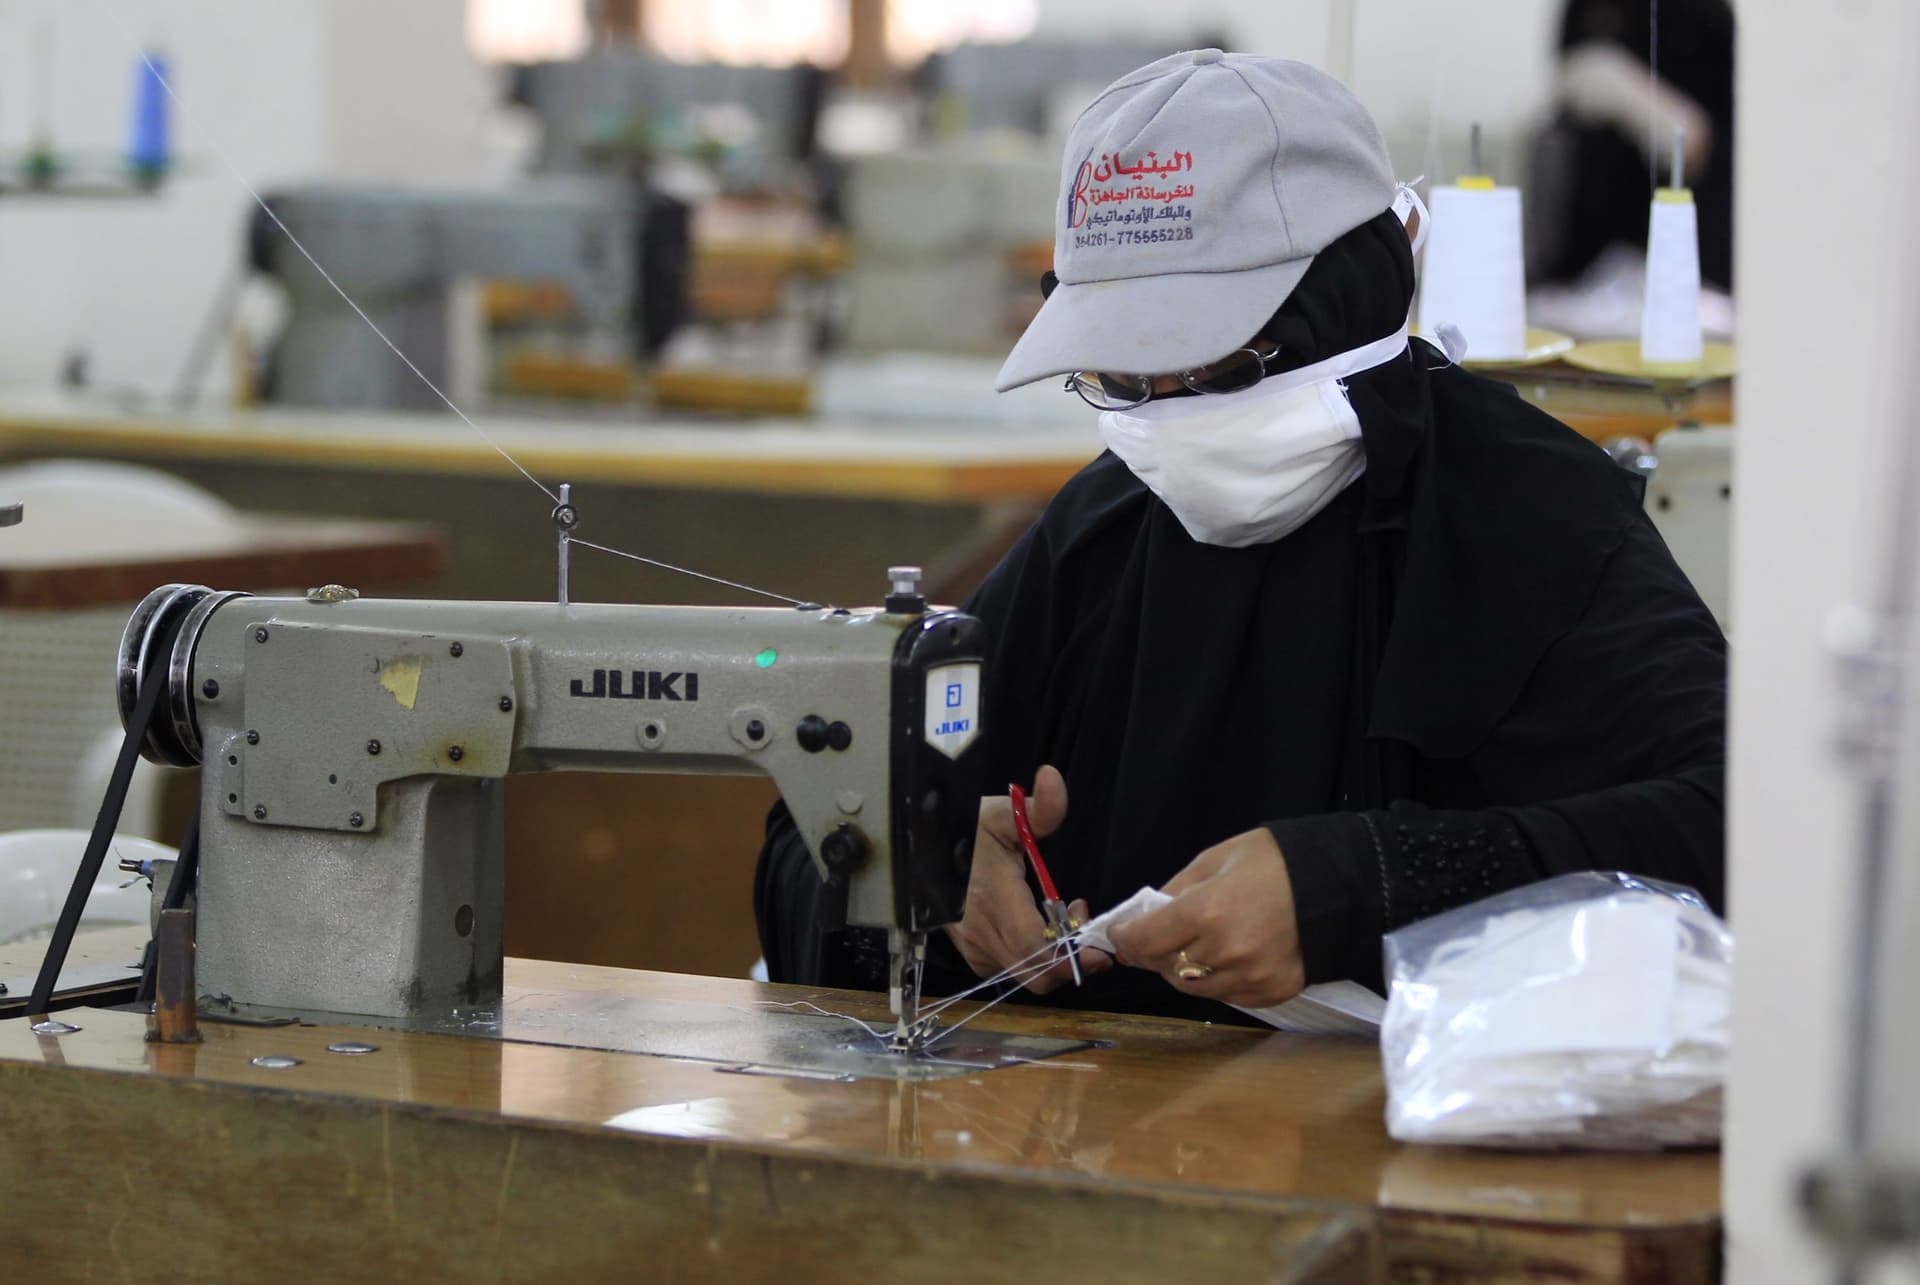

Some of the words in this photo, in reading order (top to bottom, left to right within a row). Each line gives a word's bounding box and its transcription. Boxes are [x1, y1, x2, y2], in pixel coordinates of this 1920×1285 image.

[1094, 151, 1193, 182] البنيان
[1089, 187, 1134, 206] الجاهزة
[1137, 184, 1194, 203] للخرسانة
[570, 669, 698, 701] JUKI
[935, 720, 969, 735] JUKI
